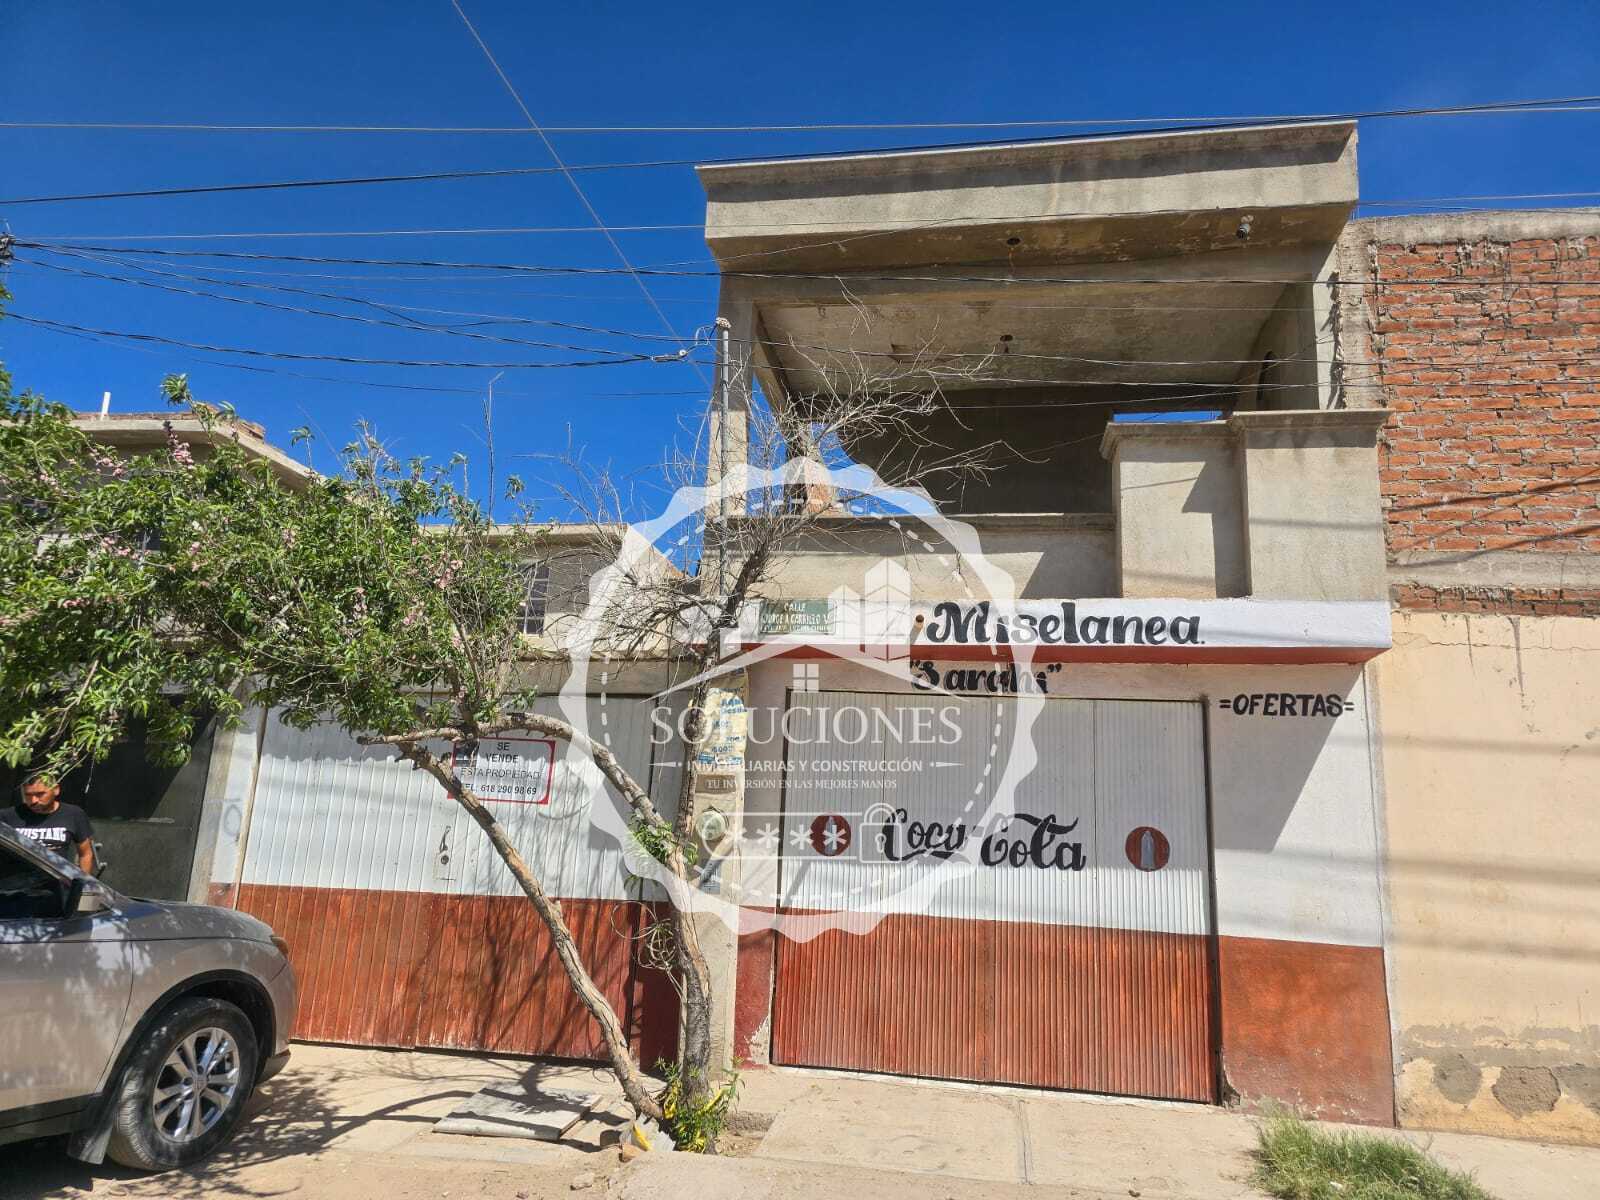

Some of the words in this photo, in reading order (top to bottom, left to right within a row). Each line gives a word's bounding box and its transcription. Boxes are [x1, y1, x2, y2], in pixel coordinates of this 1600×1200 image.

[783, 602, 806, 612] CALLE
[497, 742, 511, 751] SE
[486, 753, 519, 764] VENDE
[461, 767, 484, 777] ESTA
[485, 768, 541, 780] PROPIEDAD
[526, 787, 537, 795] 69
[980, 812, 1087, 871] Cola
